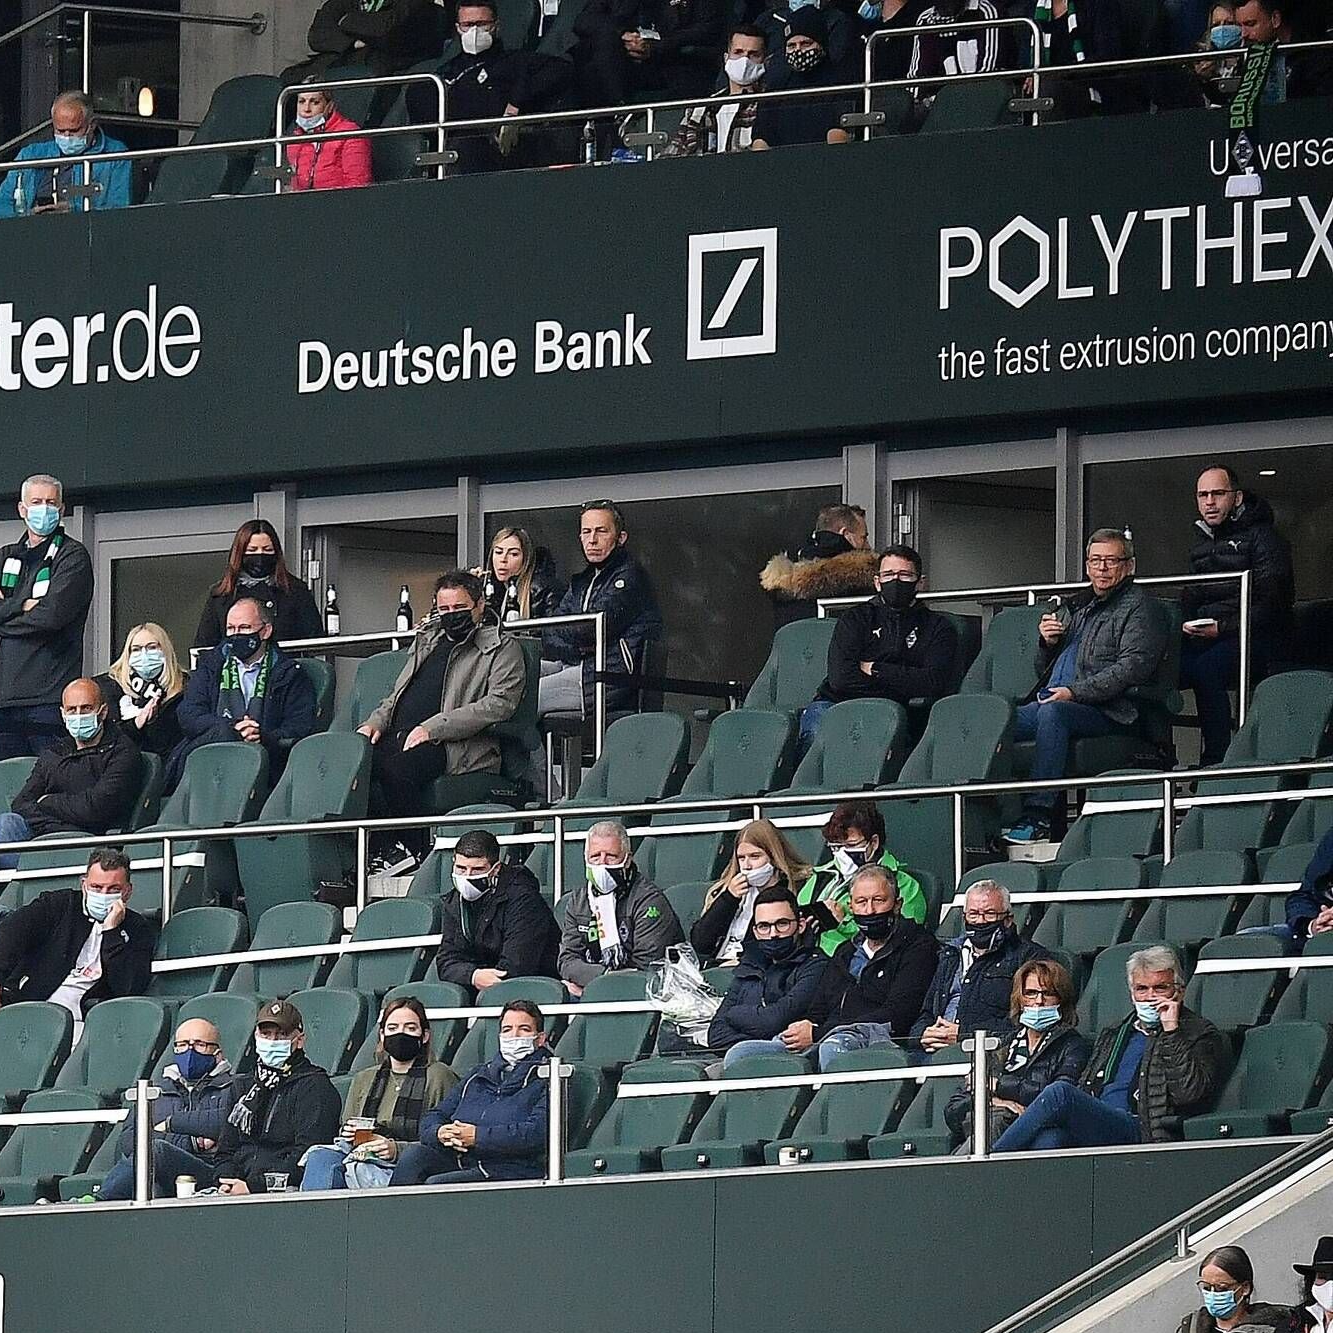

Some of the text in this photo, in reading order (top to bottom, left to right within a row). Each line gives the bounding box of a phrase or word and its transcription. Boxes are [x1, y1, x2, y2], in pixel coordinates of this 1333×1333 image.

[1209, 136, 1333, 176] Uversa
[939, 195, 1333, 310] POLYTHEX
[297, 313, 653, 394] Deutsche Bank
[938, 341, 985, 381] the
[993, 337, 1051, 377] fast
[1059, 326, 1195, 370] extrusion
